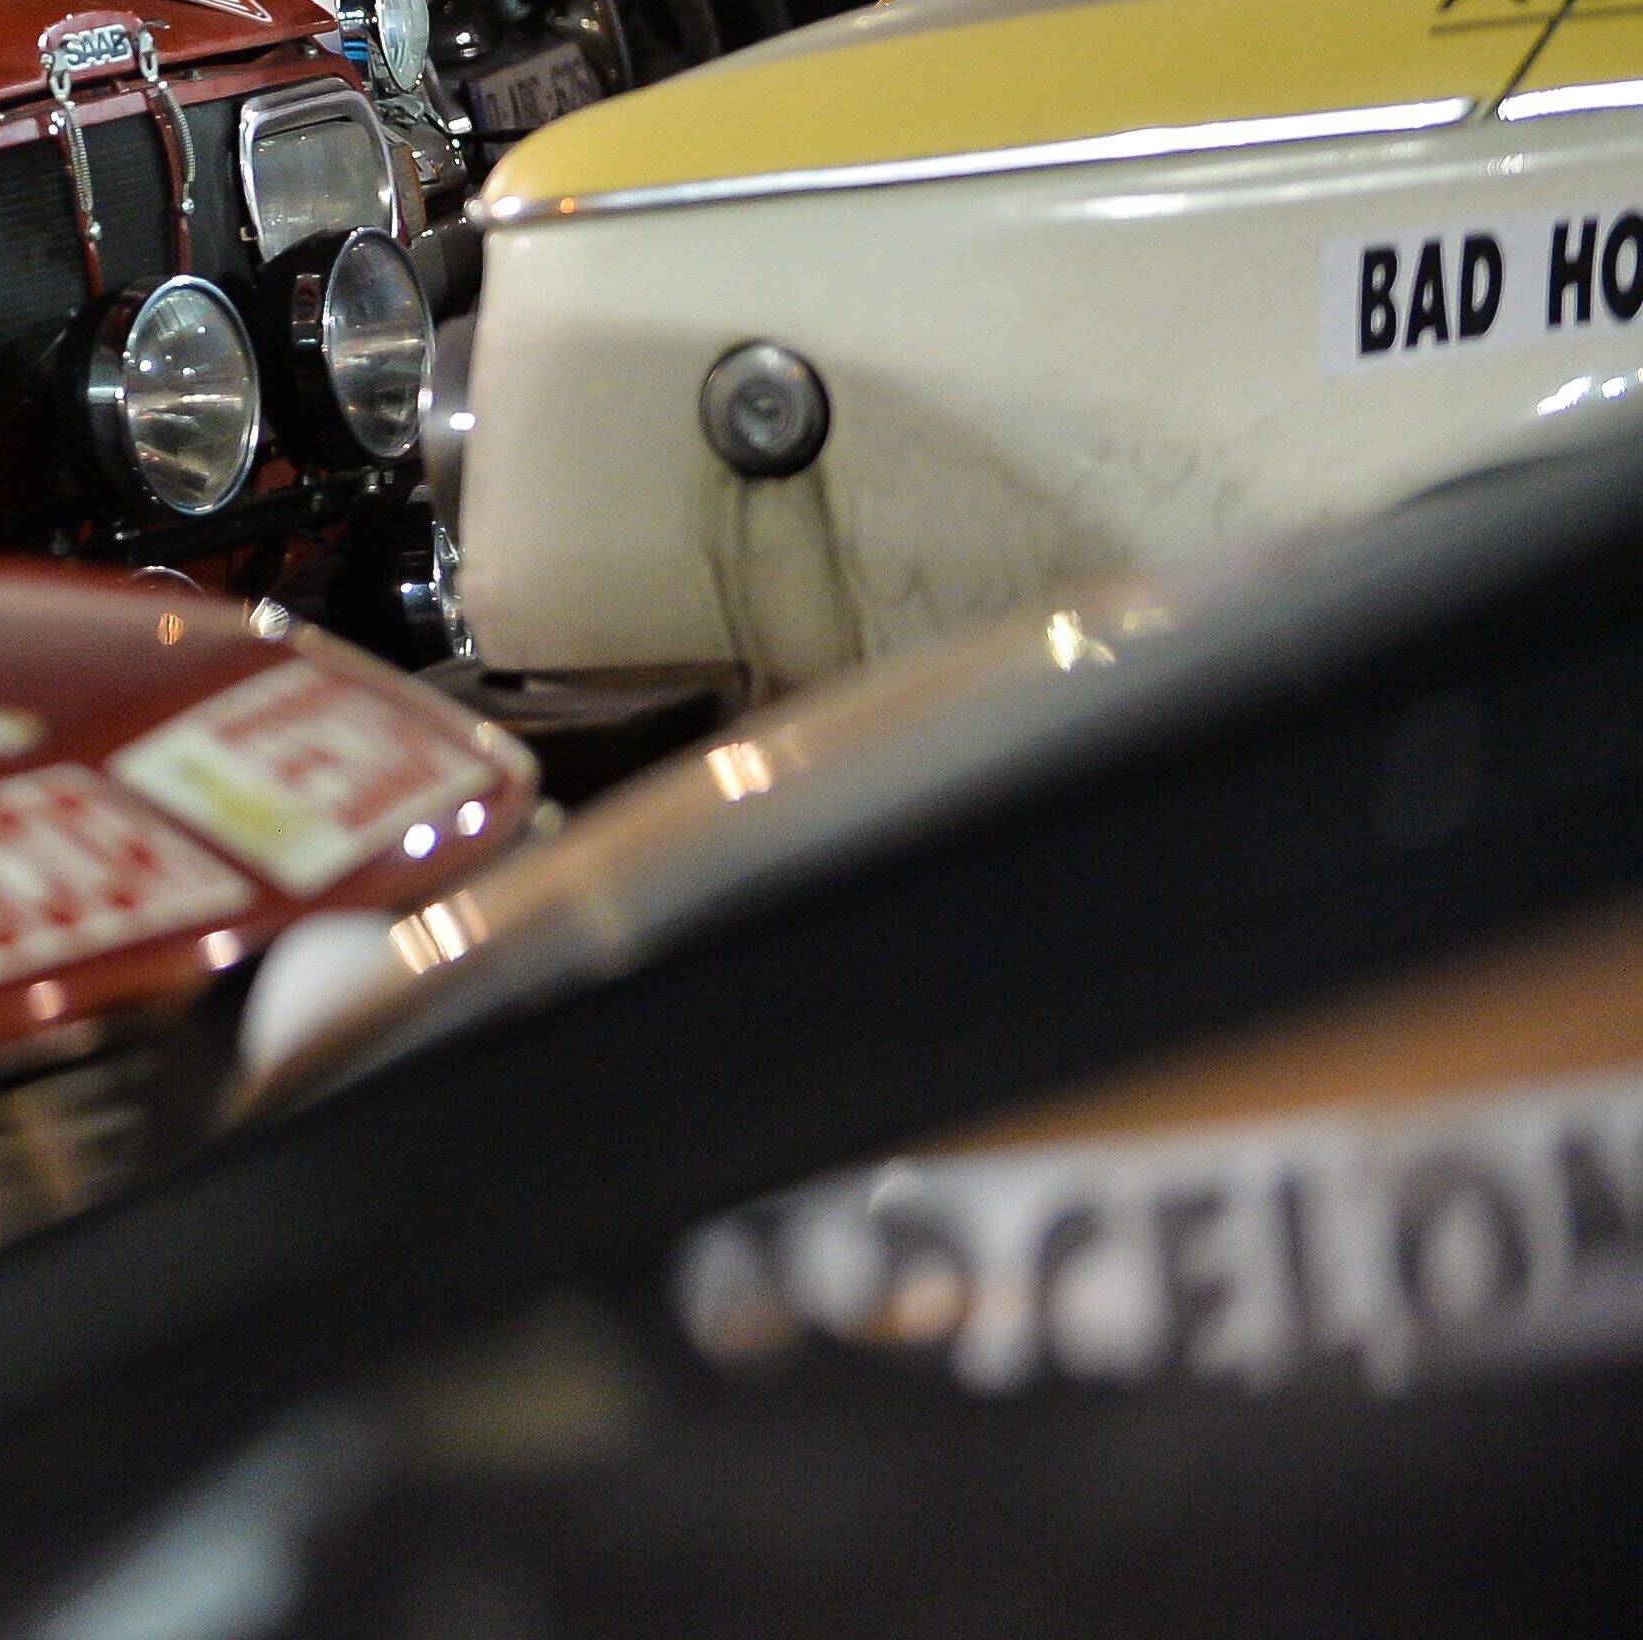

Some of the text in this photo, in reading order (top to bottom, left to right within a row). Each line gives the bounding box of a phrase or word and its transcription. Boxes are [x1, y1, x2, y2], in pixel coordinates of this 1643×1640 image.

[62, 23, 133, 70] SAAB
[1359, 211, 1643, 357] BAD HO
